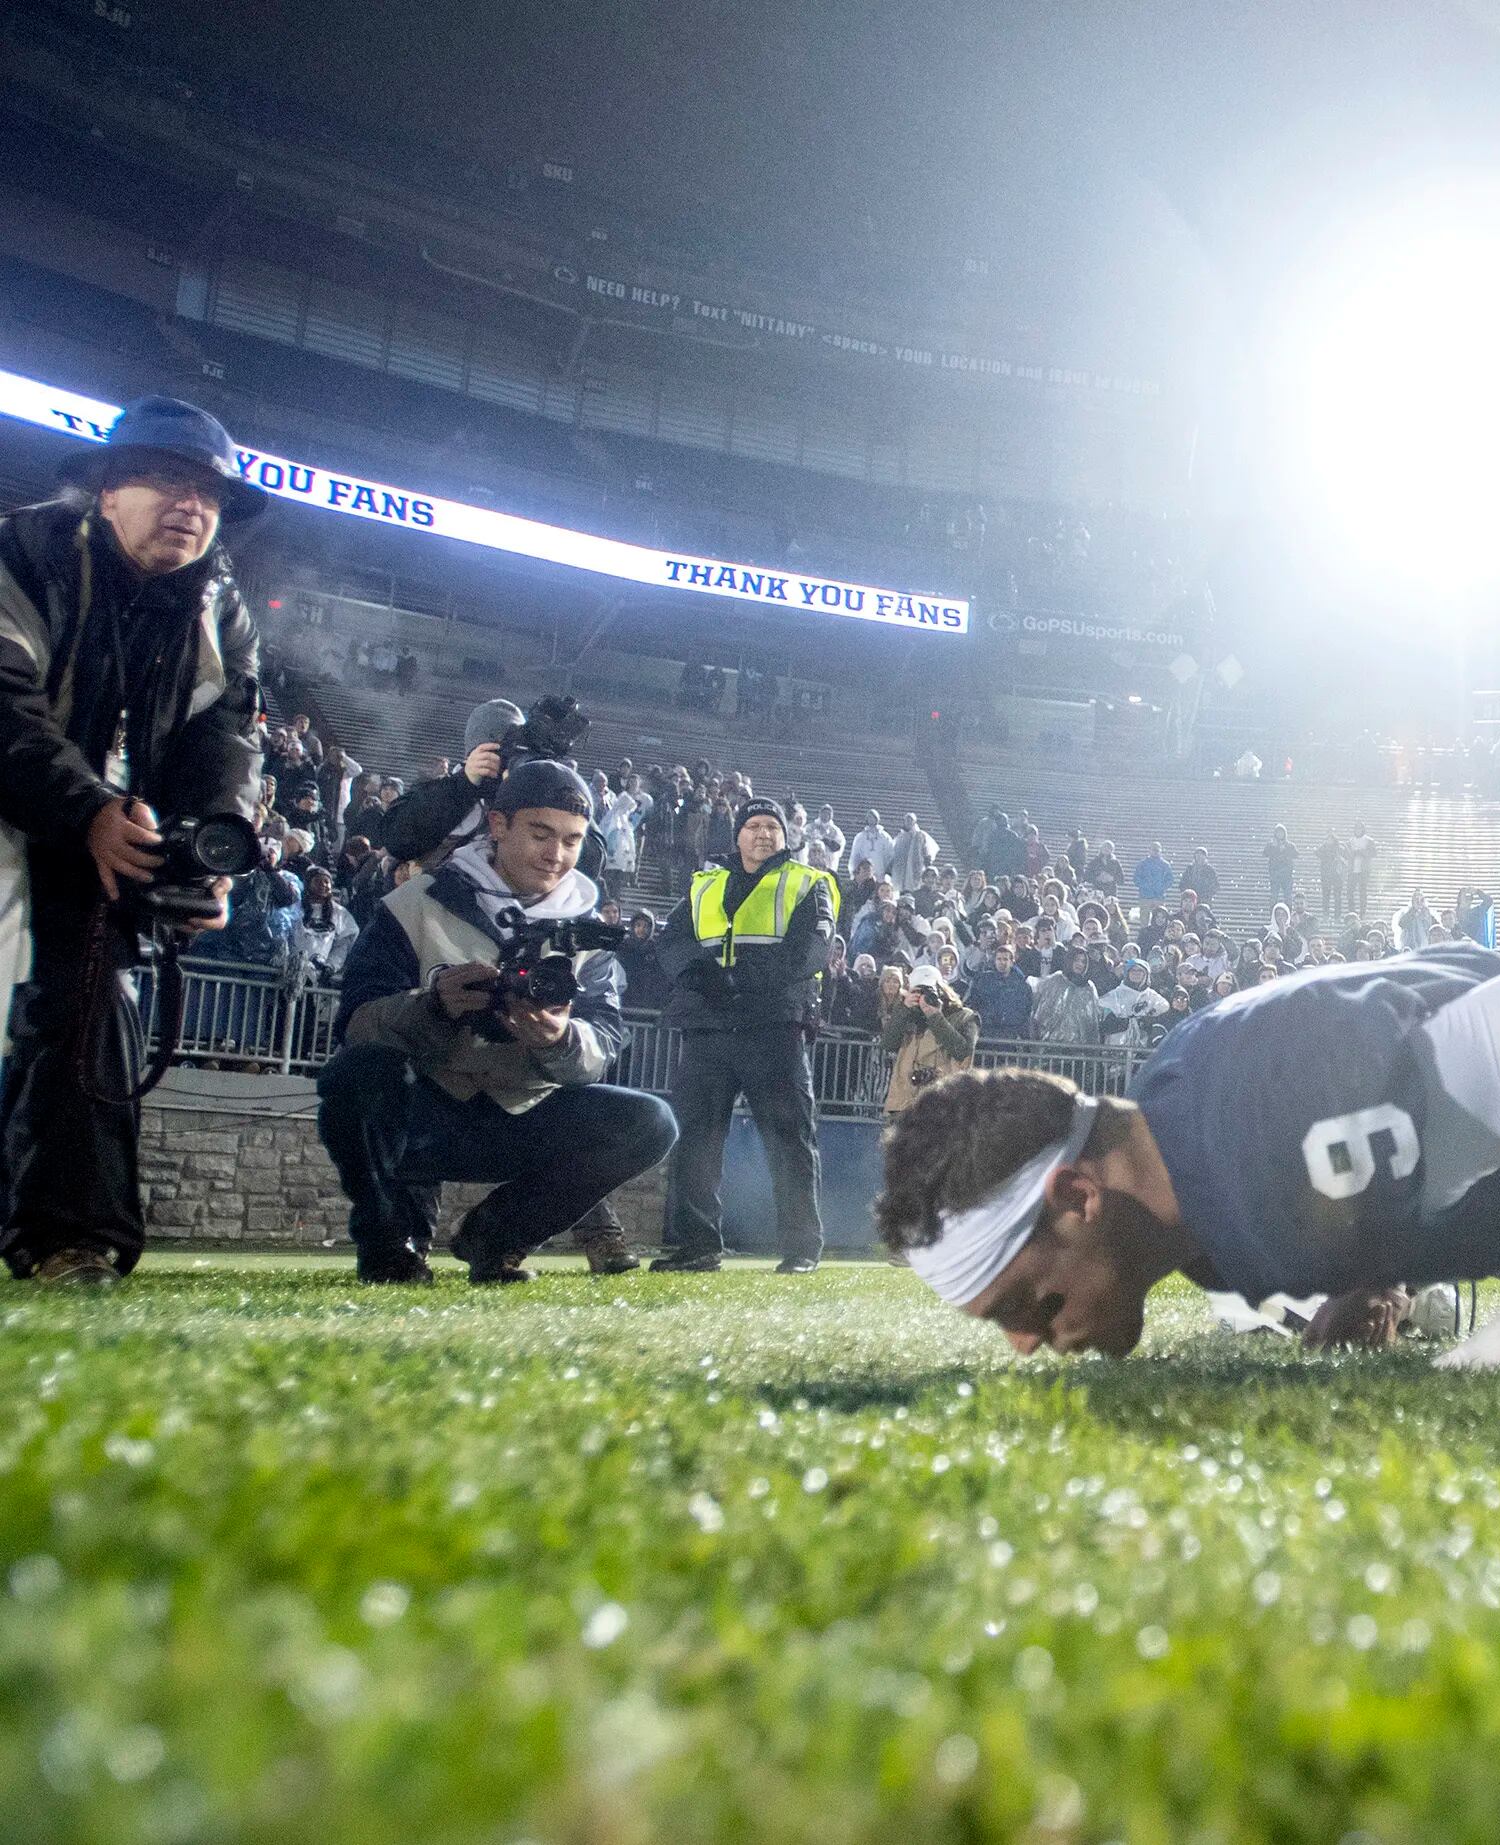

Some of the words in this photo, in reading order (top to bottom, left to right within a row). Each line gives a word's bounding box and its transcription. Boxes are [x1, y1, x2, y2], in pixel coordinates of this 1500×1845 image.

[586, 275, 625, 299] NEED
[631, 289, 681, 312] HELP?
[940, 353, 1010, 377] LOCATION
[235, 451, 316, 494] YOU
[327, 479, 435, 526] FANS
[666, 560, 789, 601] THANK
[799, 582, 865, 612] YOU
[875, 594, 961, 627] FANS
[1023, 616, 1184, 646] GoPSUsports.com
[1301, 1102, 1421, 1200] 6
